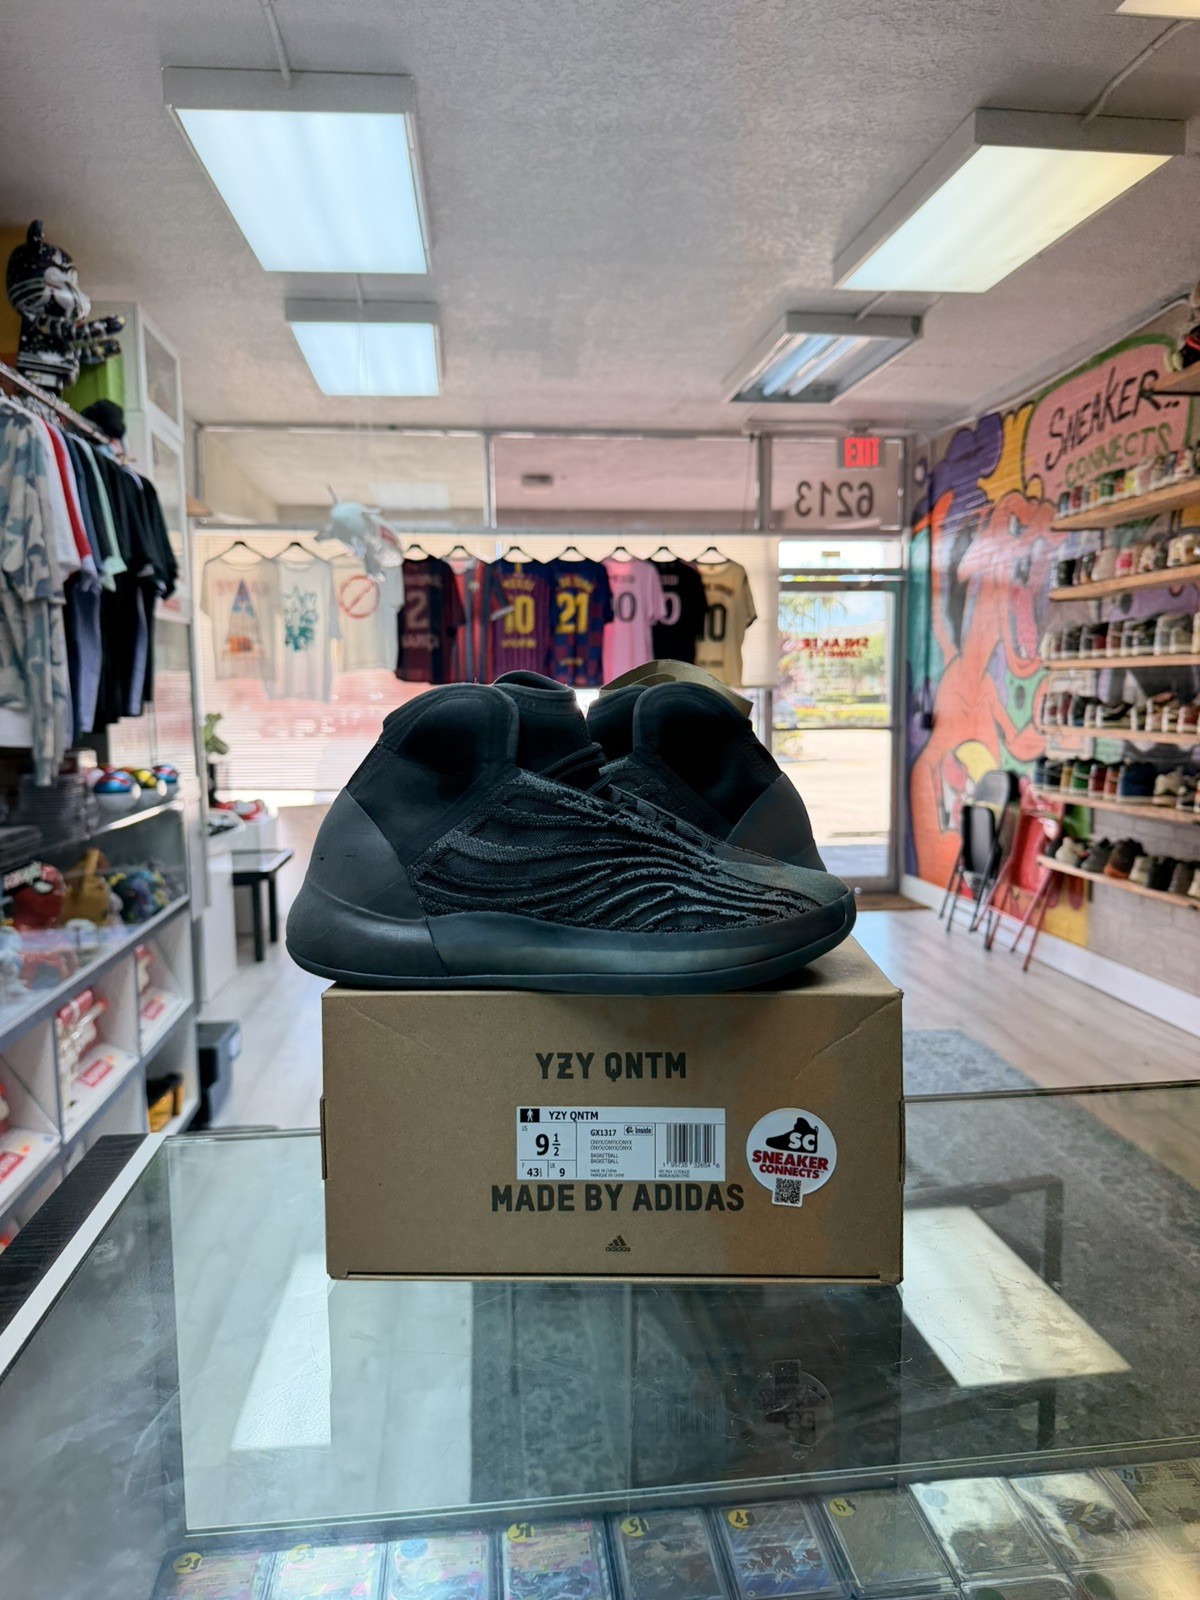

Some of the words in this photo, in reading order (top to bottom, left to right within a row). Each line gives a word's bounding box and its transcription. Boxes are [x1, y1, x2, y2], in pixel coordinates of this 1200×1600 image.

[844, 437, 880, 467] EXIT
[406, 590, 430, 629] 2
[555, 591, 589, 634] 21
[535, 1052, 595, 1079] YZY
[604, 1052, 687, 1082] QNTM
[548, 1111, 567, 1120] YZY
[570, 1111, 598, 1122] QNTM
[590, 1128, 617, 1137] GX1317
[635, 1126, 652, 1134] Inside
[787, 1131, 815, 1152] SC
[535, 1133, 549, 1156] 9
[751, 1149, 829, 1172] SNEAKER
[759, 1163, 820, 1180] CONNECTS
[559, 1168, 566, 1177] 9
[491, 1184, 575, 1212] MADE
[585, 1184, 624, 1212] BY
[632, 1183, 745, 1212] ADIDAS
